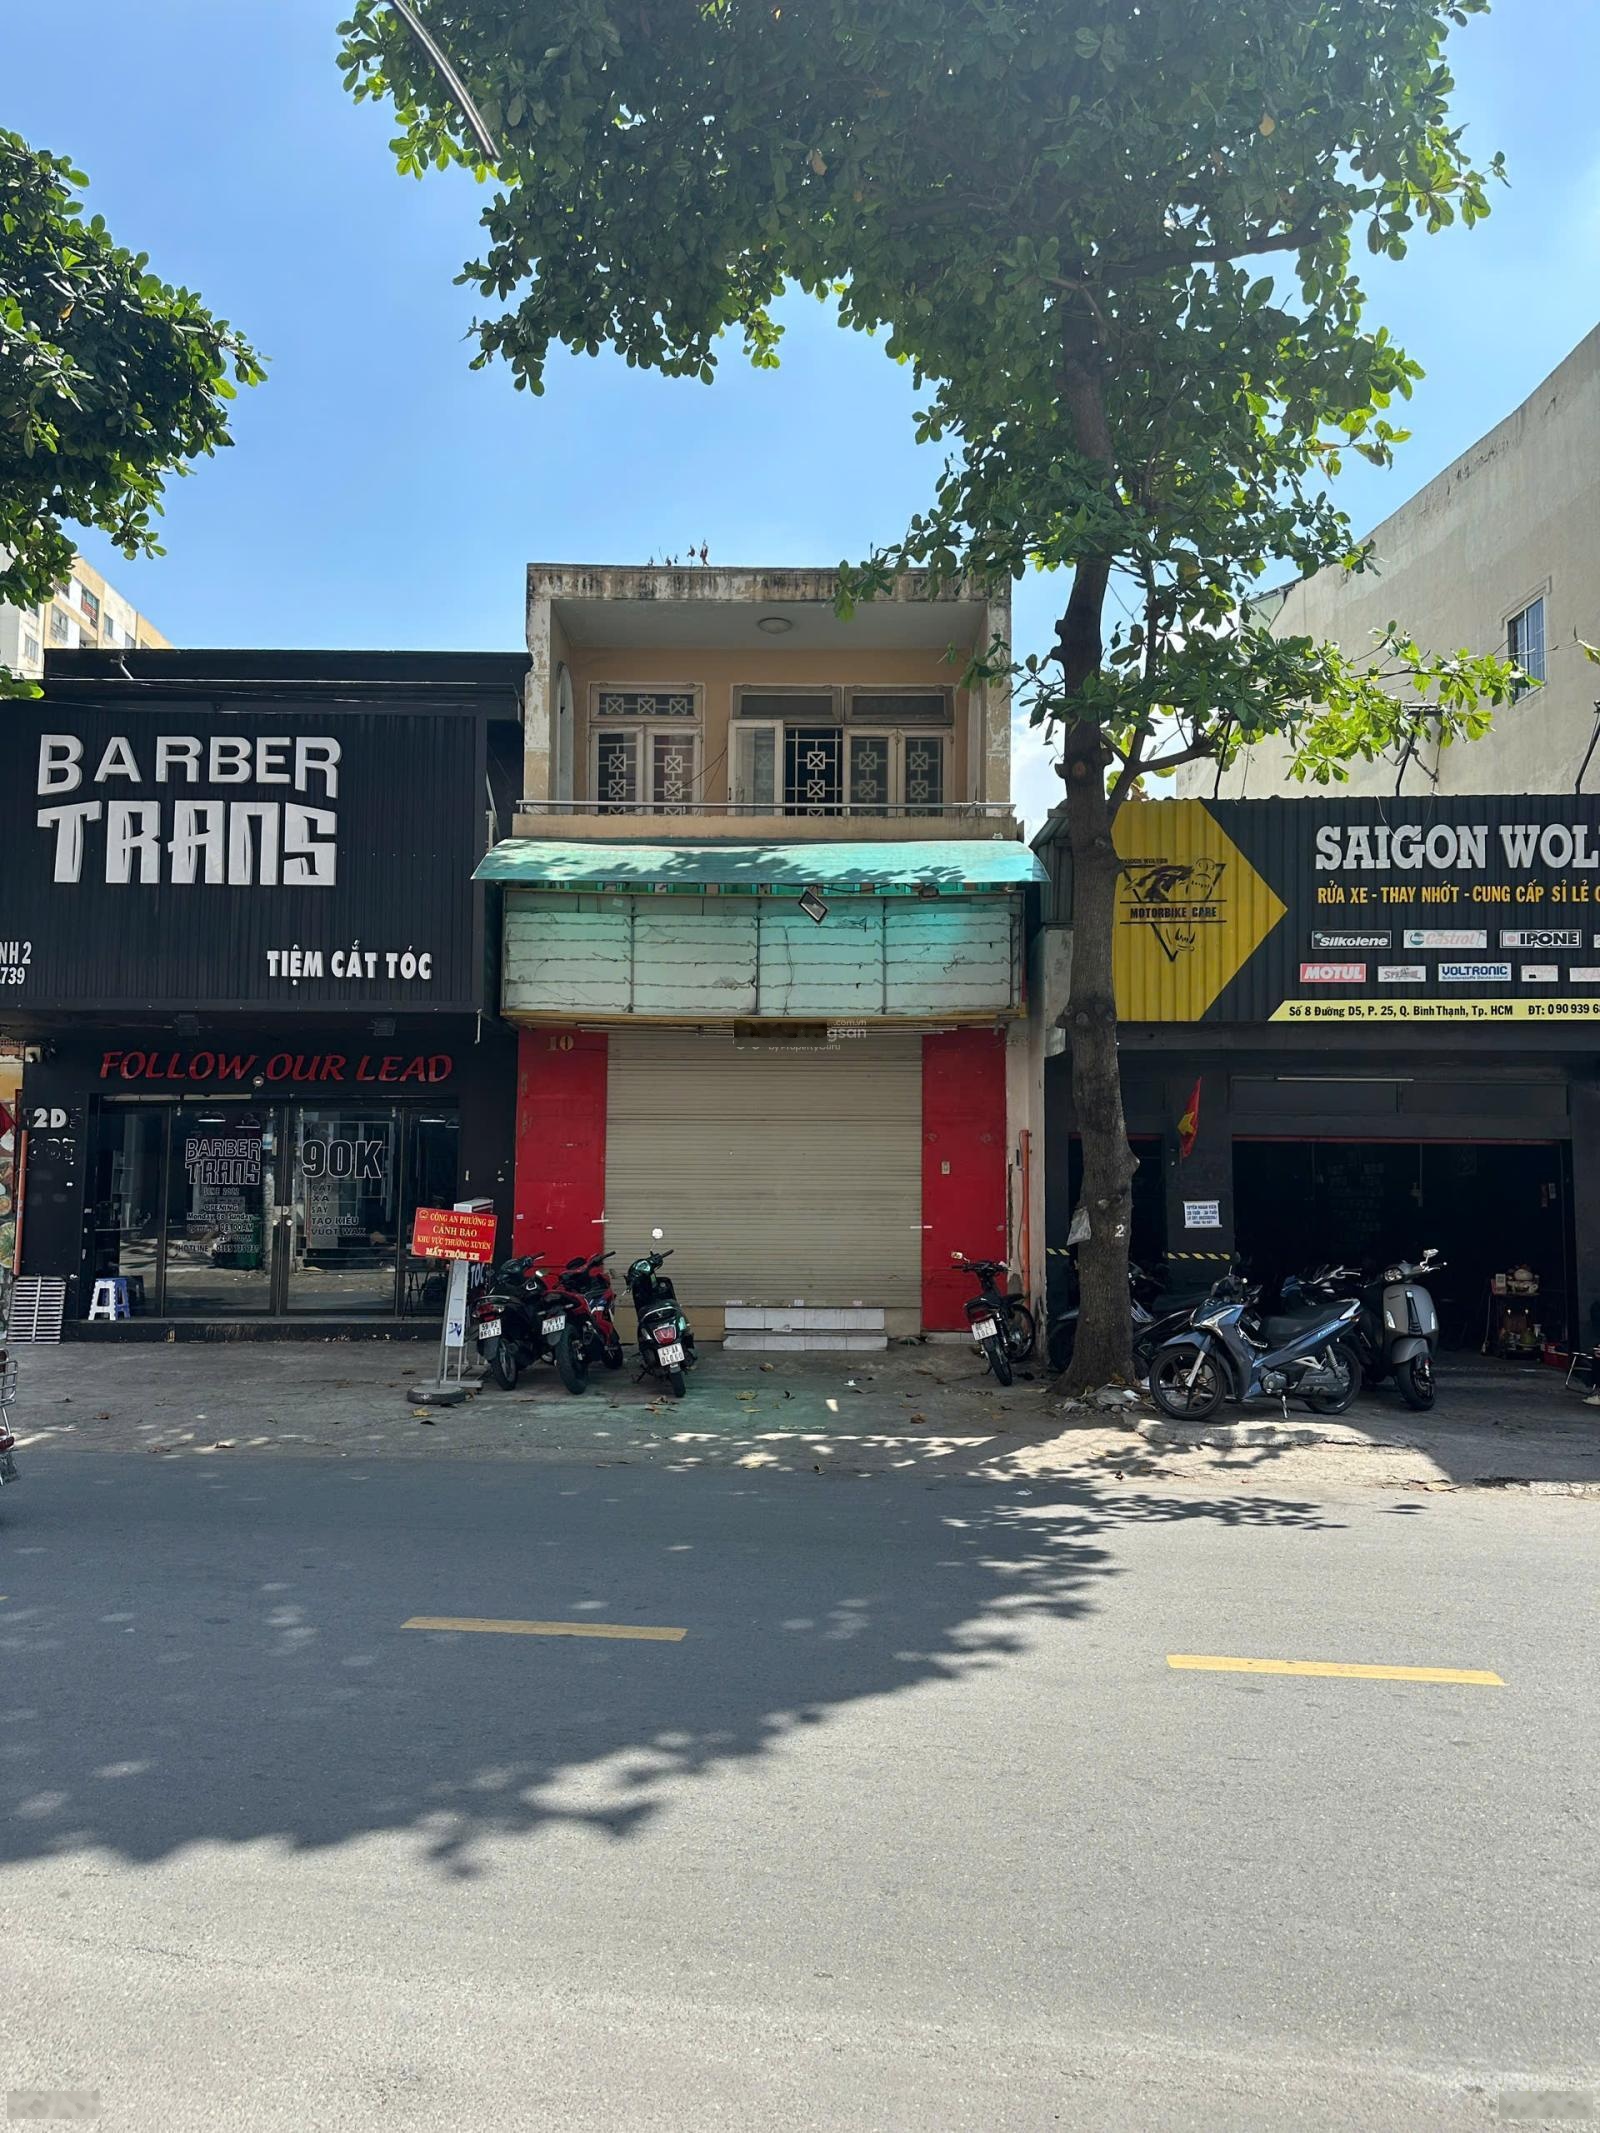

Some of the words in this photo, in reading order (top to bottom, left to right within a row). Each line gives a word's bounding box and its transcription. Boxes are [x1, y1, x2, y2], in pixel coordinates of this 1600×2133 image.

[37, 734, 342, 799] BARBER
[37, 800, 337, 886] TRANS
[1315, 824, 1488, 870] SAIGON
[1499, 823, 1600, 869] WOL
[1317, 880, 1345, 904] RỬA
[1350, 887, 1368, 903] XE
[1381, 886, 1416, 903] THAY
[1422, 881, 1459, 903] NHỚT
[1472, 886, 1511, 903] CUNG
[1515, 879, 1544, 903] CẤP
[1572, 879, 1589, 902] LẺ
[1130, 907, 1187, 919] MOTORBIKE
[1192, 906, 1217, 918] CARE
[1319, 936, 1389, 947] Silkolene
[1425, 931, 1475, 946] Castrol
[1520, 931, 1578, 946] IPONE
[21, 941, 32, 964] 2
[266, 944, 324, 986] TIỆM
[331, 939, 378, 979] CẮT
[385, 945, 433, 980] TÓC
[1303, 965, 1364, 980] MOTUL
[1441, 965, 1509, 976] VOLTRONIC
[1289, 1005, 1302, 1016] Số
[1304, 1006, 1312, 1016] 8
[1314, 1005, 1346, 1017] Đường
[1348, 1006, 1365, 1017] D5,
[1367, 1006, 1378, 1016] P.
[1380, 1006, 1397, 1017] 25,
[1399, 1006, 1410, 1016] Q.
[1472, 1006, 1488, 1017] Tp.
[1491, 1005, 1513, 1015] HCM
[1528, 1005, 1545, 1015] ĐT:
[1570, 1004, 1590, 1014] 939
[545, 1035, 574, 1051] 10
[100, 1051, 258, 1081] FOLLOW
[266, 1052, 347, 1081] OUR
[355, 1054, 453, 1082] LEAD
[33, 1107, 68, 1128] 2D
[185, 1138, 262, 1162] BARBER
[302, 1139, 383, 1179] 90K
[185, 1159, 261, 1185] TRANS
[430, 1212, 448, 1221] CÔNG
[487, 1219, 495, 1227] 25
[432, 1222, 457, 1236] CẢNH
[1114, 1224, 1125, 1238] 2
[417, 1235, 431, 1244] KHU
[425, 1246, 443, 1257] MẤT
[468, 1252, 480, 1260] XE
